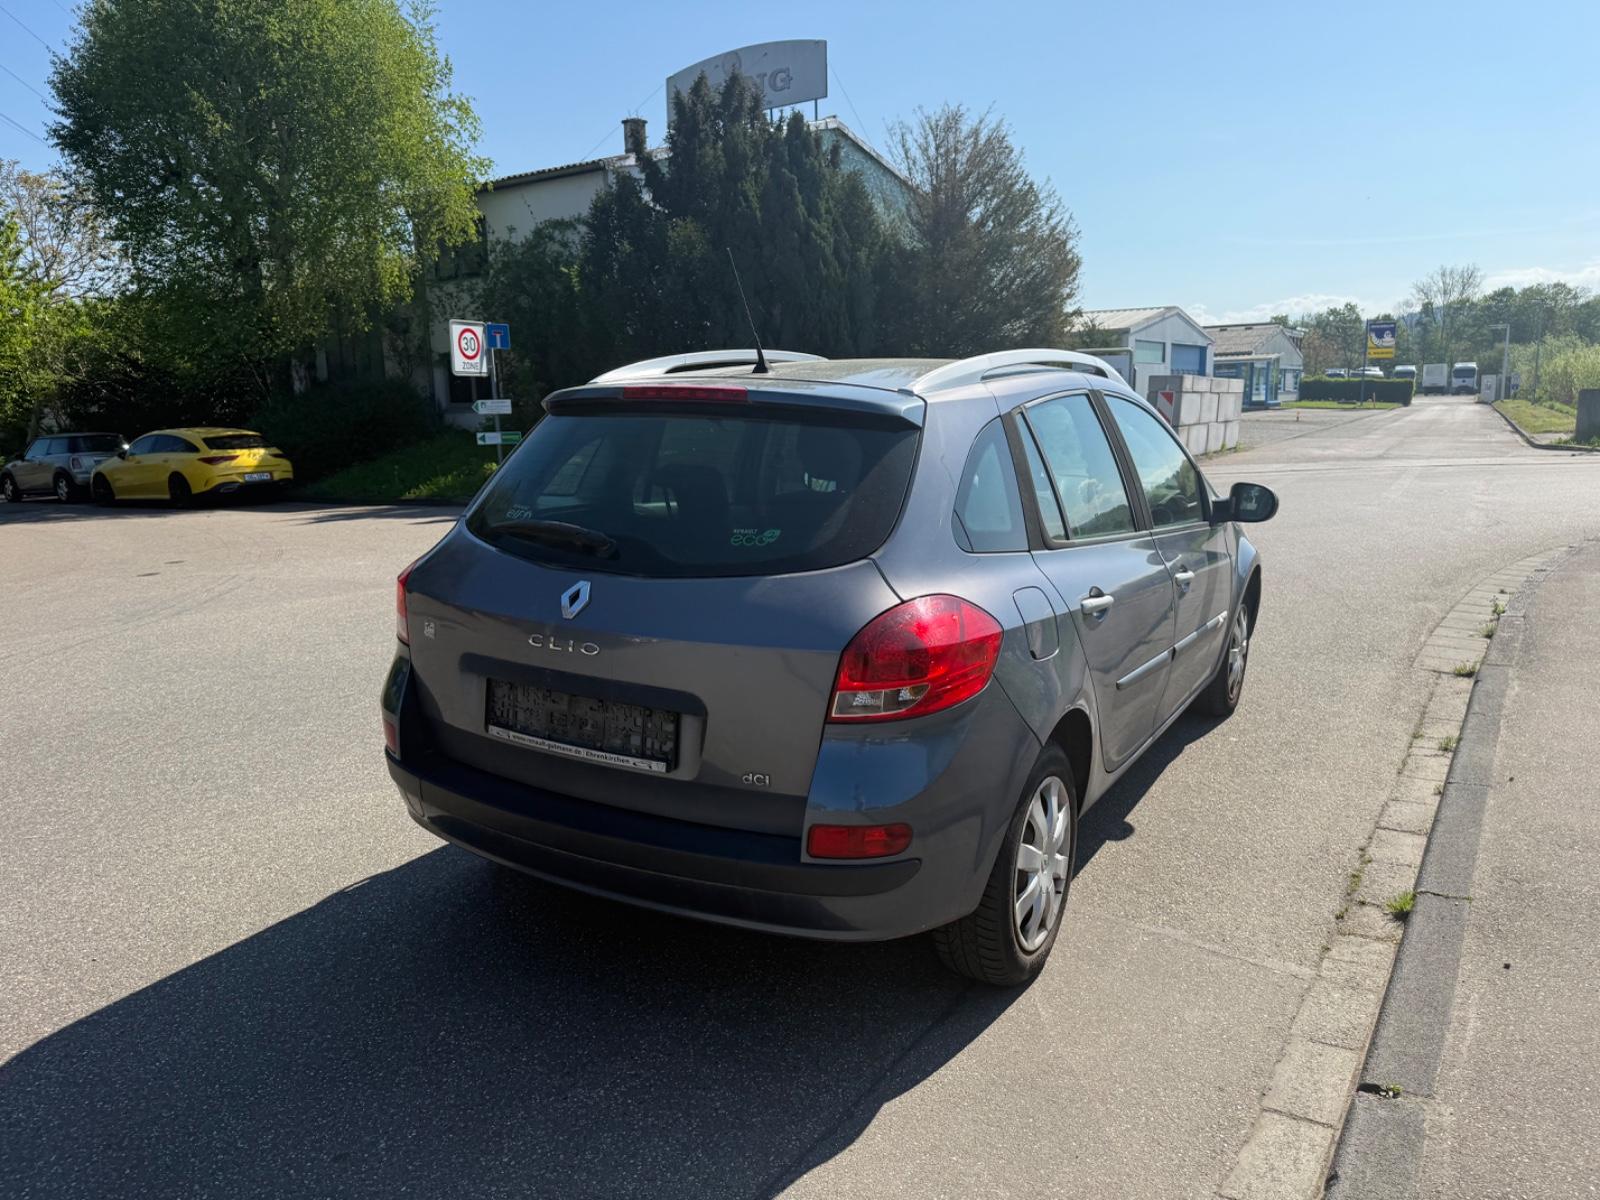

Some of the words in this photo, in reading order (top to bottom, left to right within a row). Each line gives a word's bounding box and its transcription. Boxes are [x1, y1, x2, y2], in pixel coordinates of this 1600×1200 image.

[462, 336, 476, 352] 30
[462, 361, 480, 371] ZONE
[528, 633, 600, 656] CLIO
[585, 751, 630, 764] Ehrenkirchen
